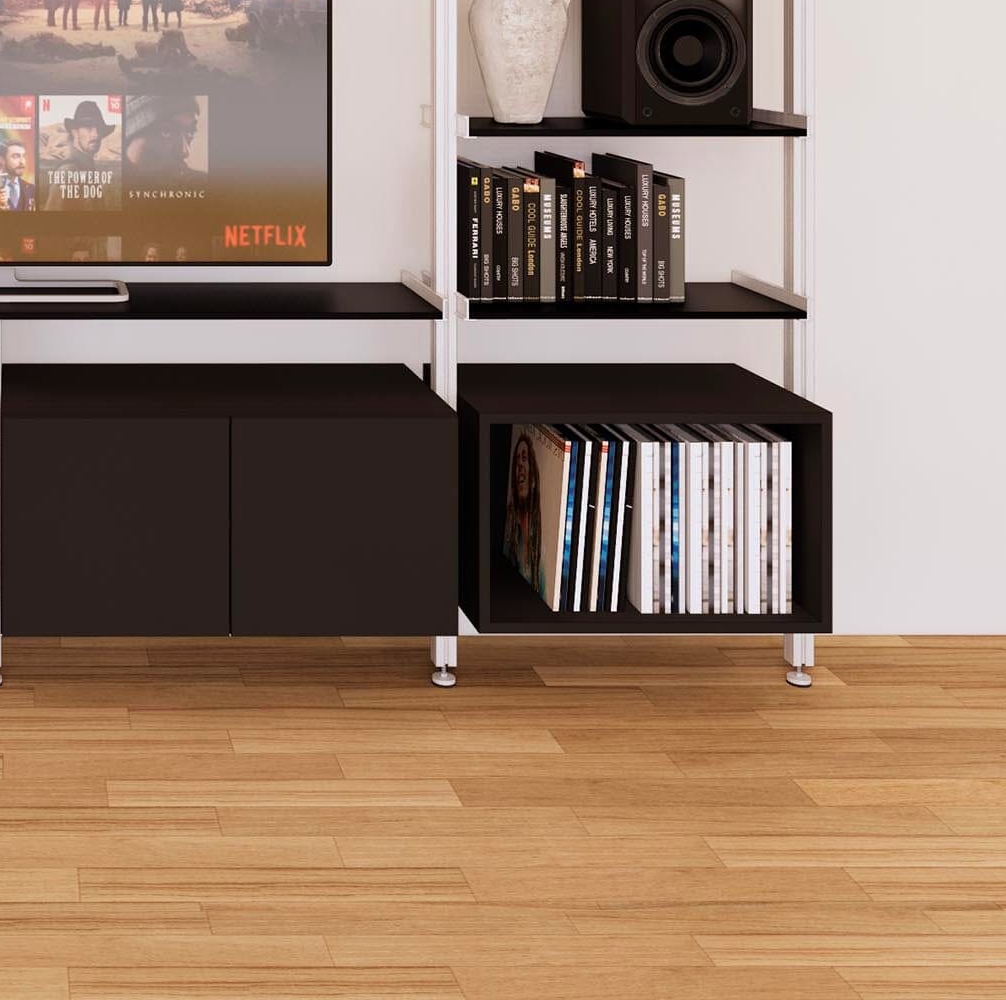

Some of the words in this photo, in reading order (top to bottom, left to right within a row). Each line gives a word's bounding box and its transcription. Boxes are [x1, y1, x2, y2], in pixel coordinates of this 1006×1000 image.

[48, 171, 66, 184] THE
[68, 171, 100, 184] POWER
[102, 171, 113, 184] OF
[60, 184, 80, 199] THE
[84, 184, 103, 199] DOG
[129, 190, 206, 199] SYNCHRONIC
[512, 187, 520, 211] GABO
[588, 186, 596, 208] LUXURY
[528, 203, 536, 224] COOL
[606, 198, 614, 218] LUXURY
[624, 196, 632, 216] LUXURY
[658, 194, 666, 216] GABO
[544, 194, 552, 240] MUSEUMS
[588, 210, 596, 232] HOTELS
[606, 219, 614, 236] LIVING
[672, 194, 680, 240] MUSEUMS
[224, 225, 307, 248] NETFLIX
[528, 226, 536, 248] GUIDE
[560, 232, 568, 248] ANGELS
[624, 218, 632, 240] HOUSES
[528, 250, 536, 276] London
[588, 239, 596, 265] AMERICA
[606, 246, 614, 258] NEW
[606, 259, 614, 274] YORK
